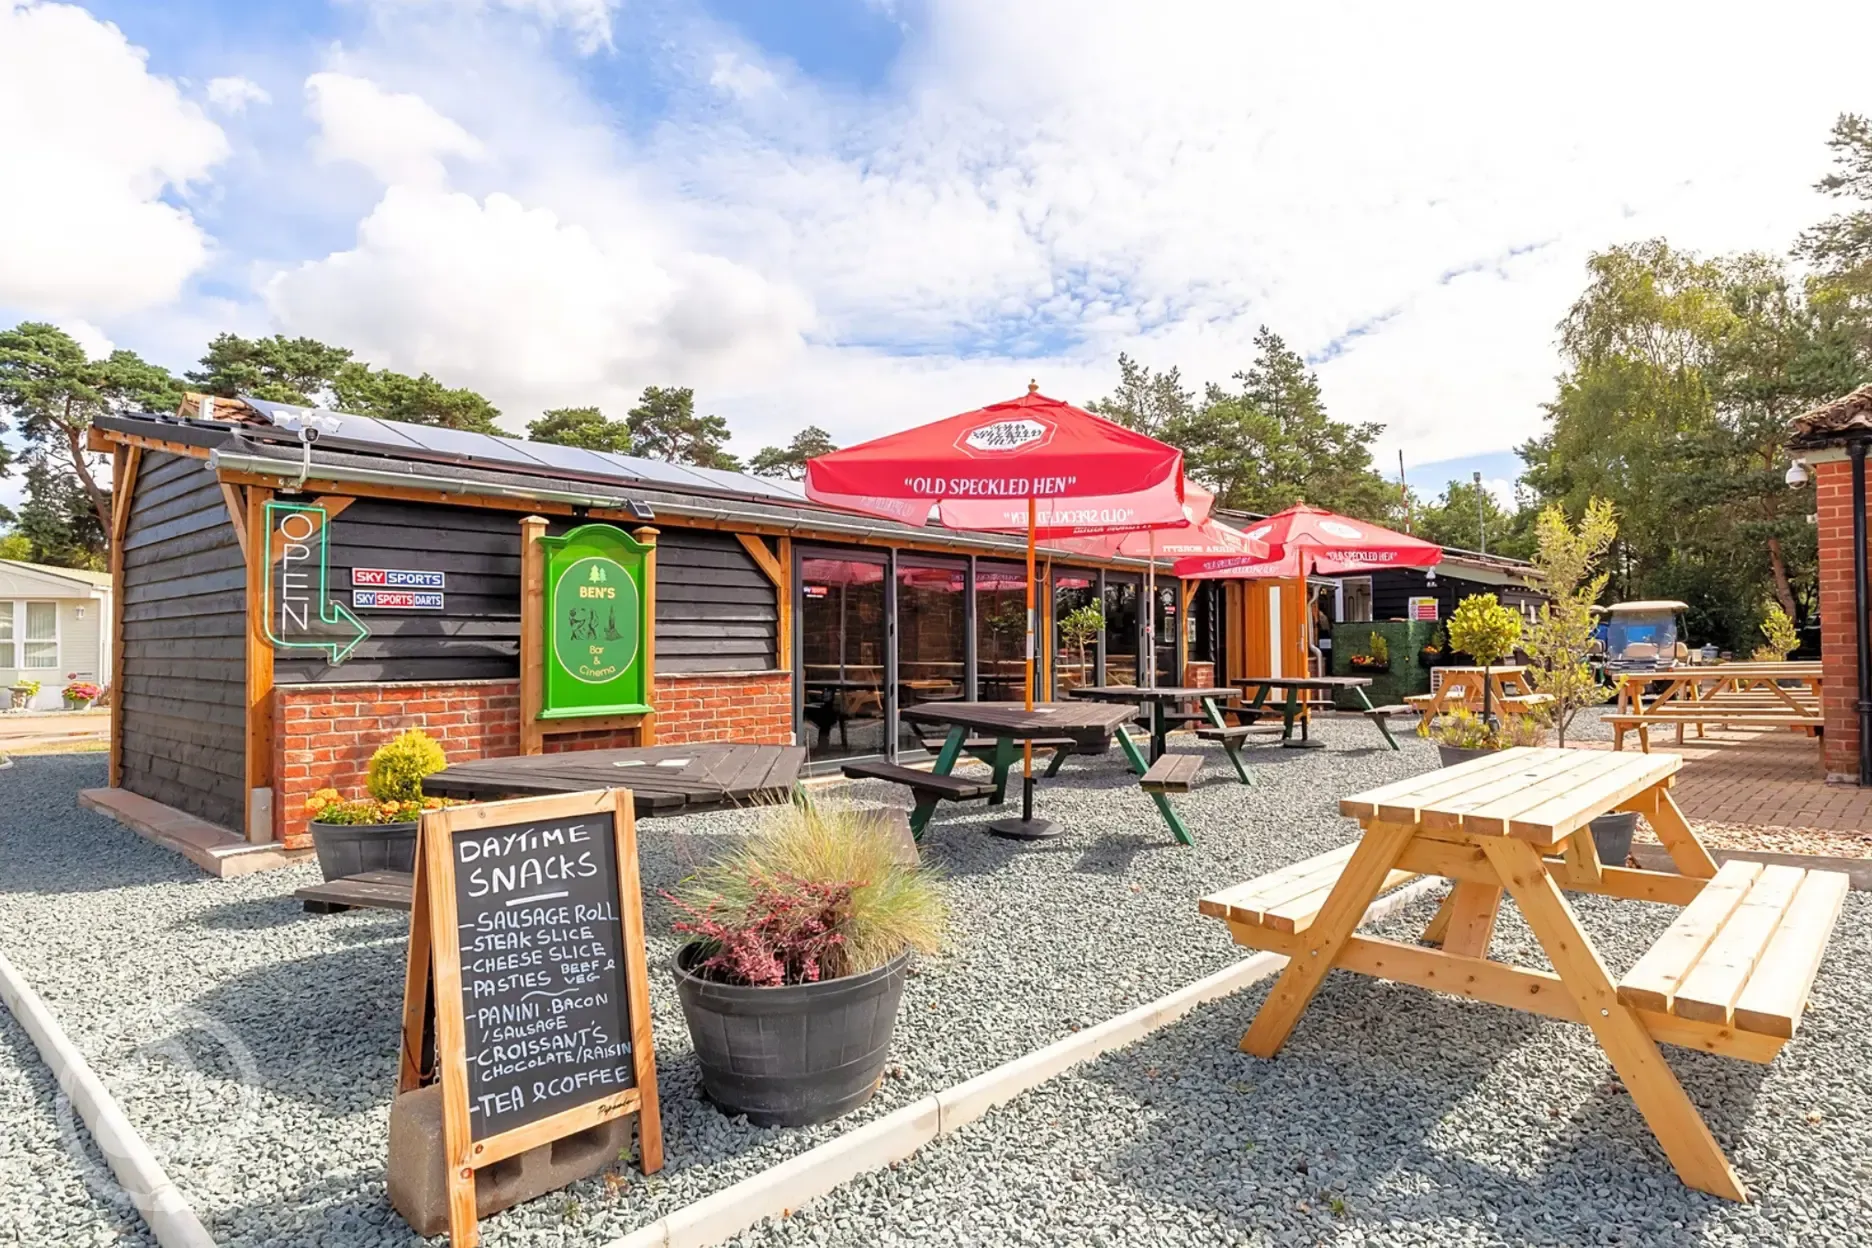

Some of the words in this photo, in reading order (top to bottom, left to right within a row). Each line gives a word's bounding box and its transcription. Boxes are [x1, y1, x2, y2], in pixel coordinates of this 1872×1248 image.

[949, 478, 1029, 495] SPECKLED
[280, 513, 313, 631] OPEN
[356, 571, 384, 582] SKY
[388, 573, 441, 585] SPORTS
[356, 593, 375, 604] SKY
[377, 594, 413, 605] SPORTS
[415, 595, 441, 606] DARTS
[579, 585, 616, 599] BEN'S
[589, 645, 604, 655] Bar
[593, 656, 601, 665] &
[579, 665, 616, 677] Cinema
[459, 825, 592, 863] DAYTIME
[468, 851, 598, 898] SNACKS
[574, 901, 619, 924] ROLL
[536, 926, 595, 945] SLICE
[548, 942, 607, 962] SLICE
[560, 960, 600, 975] BEEF
[563, 972, 601, 984] VEG
